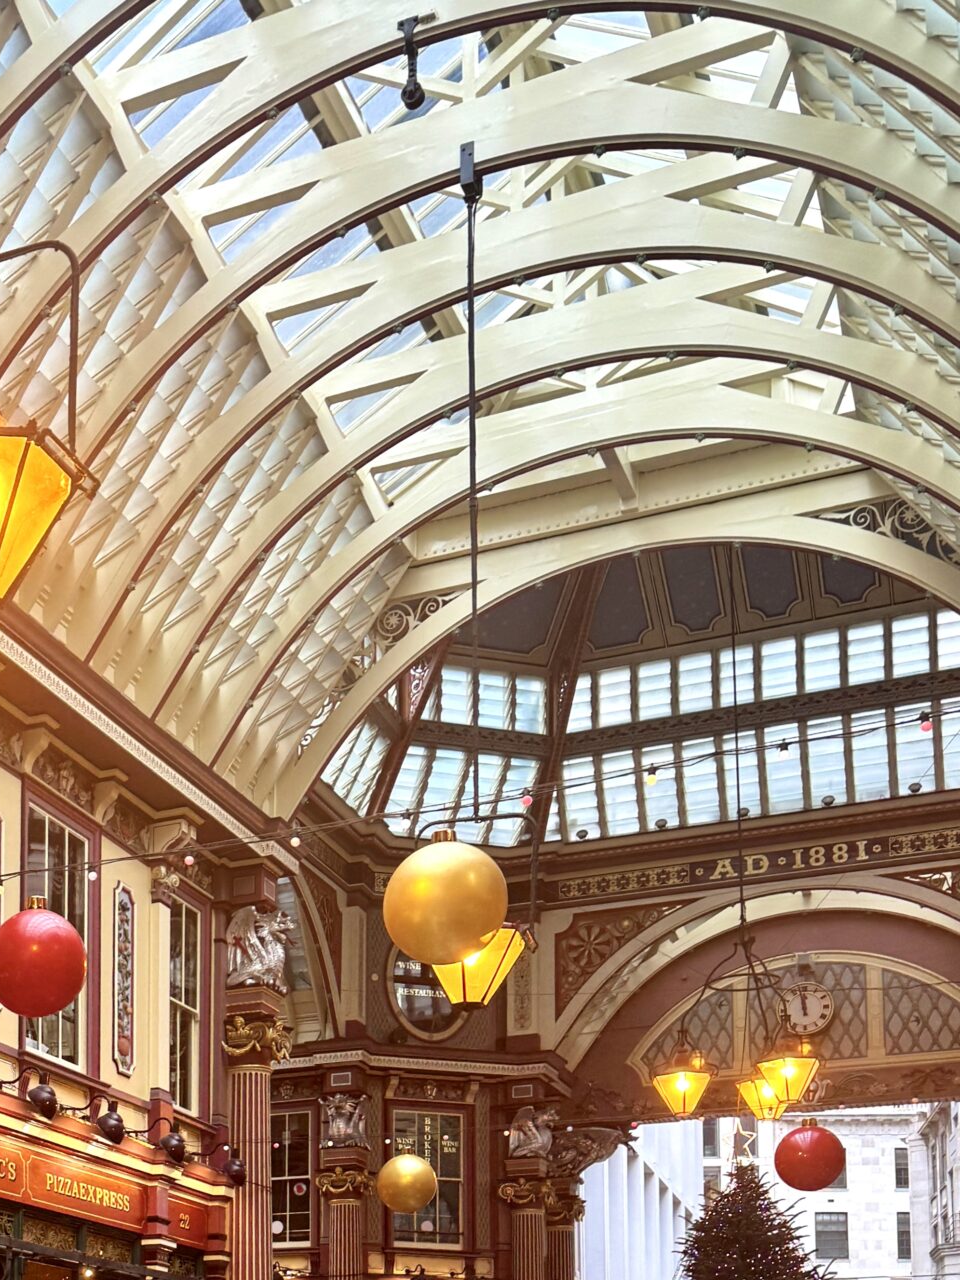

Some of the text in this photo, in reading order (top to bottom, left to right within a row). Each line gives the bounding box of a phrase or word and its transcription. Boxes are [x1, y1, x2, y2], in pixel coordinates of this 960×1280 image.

[792, 840, 869, 869] 1881
[396, 961, 421, 969] WINE
[45, 1172, 131, 1213] PIZZAEXPRESS
[179, 1213, 191, 1230] 22
